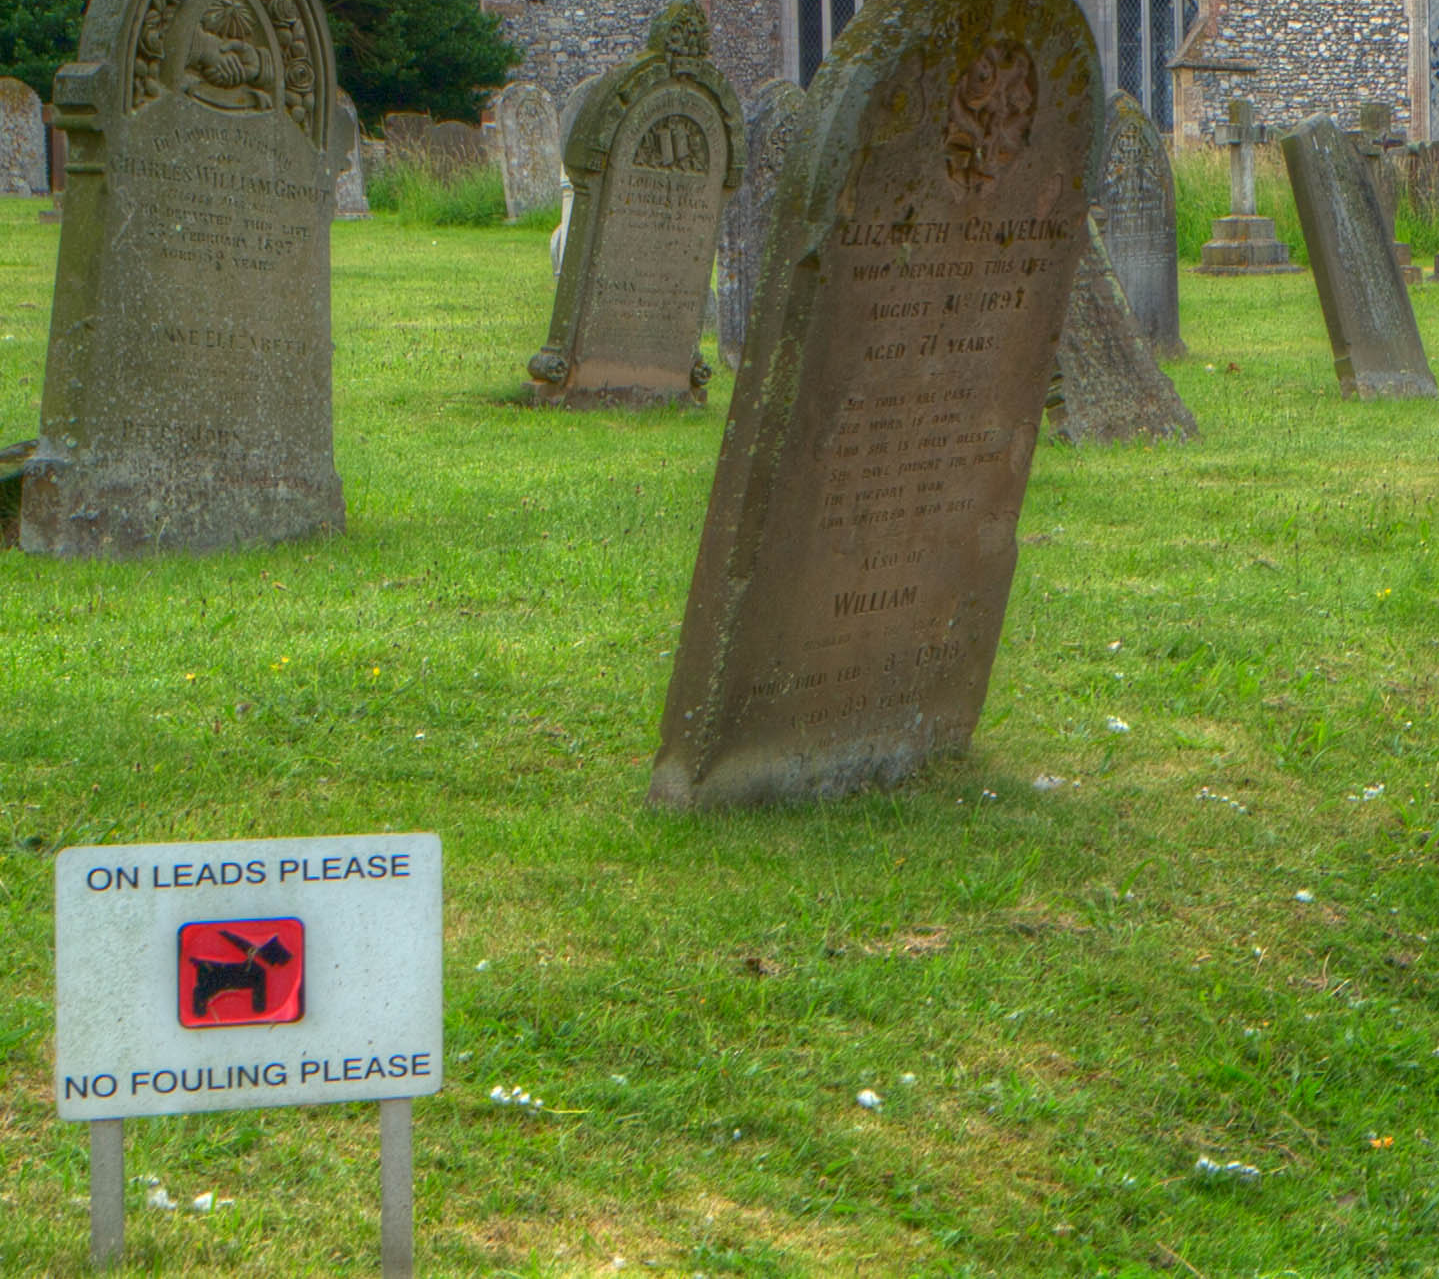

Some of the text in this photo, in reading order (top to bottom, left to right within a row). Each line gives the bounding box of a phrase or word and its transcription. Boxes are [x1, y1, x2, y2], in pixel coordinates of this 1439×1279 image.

[195, 163, 271, 196] WILLIAM
[898, 261, 974, 279] DEPARTED
[984, 259, 1015, 275] THIS
[871, 301, 933, 320] AUGUST
[863, 343, 906, 362] AGED
[833, 585, 918, 618] WILLIAM
[87, 854, 411, 891] ON LEADS PLEASE
[65, 1053, 432, 1100] NO FOULING PLEASE
